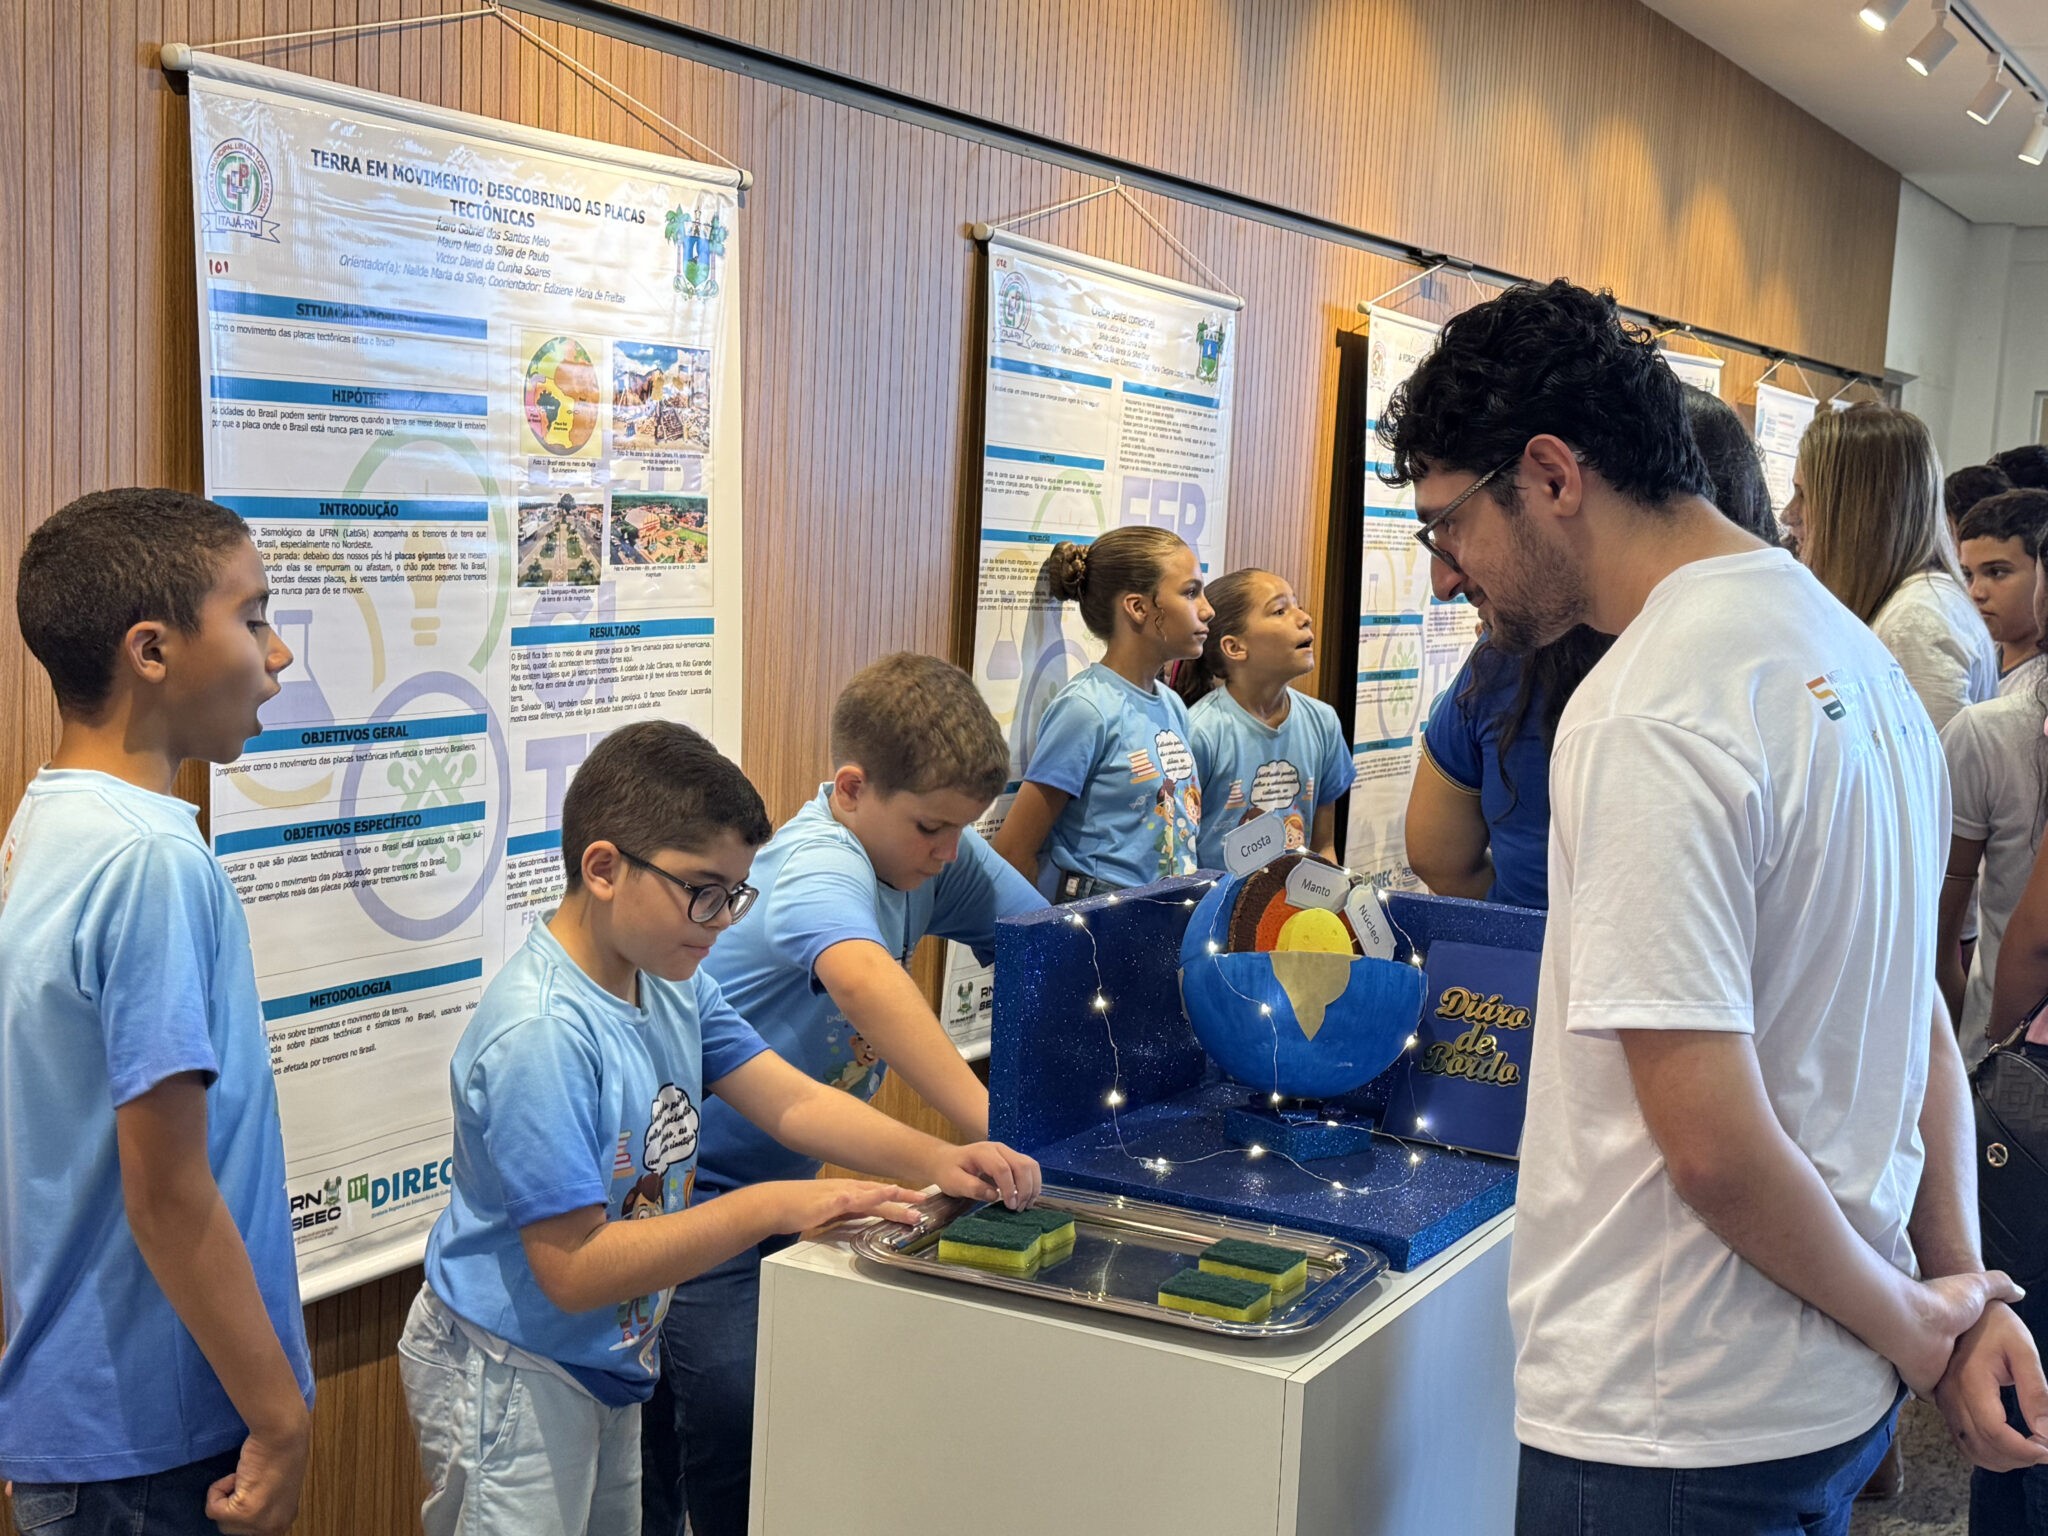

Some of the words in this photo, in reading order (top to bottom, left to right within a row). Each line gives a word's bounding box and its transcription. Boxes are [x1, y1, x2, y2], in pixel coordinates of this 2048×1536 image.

[311, 149, 361, 174] TERRA
[367, 159, 388, 179] EM
[393, 164, 483, 195] MOVIMENTO:
[487, 182, 582, 213] DESCOBRINDO
[586, 200, 601, 216] AS
[605, 204, 646, 224] PLACAS
[218, 216, 258, 230] ITAJÁ-RN
[450, 199, 535, 228] TECTÔNICAS
[458, 223, 484, 238] Gabriel
[486, 227, 500, 240] dos
[502, 230, 530, 244] Santos
[532, 234, 550, 248] Melo
[437, 236, 462, 249] Mauro
[464, 241, 482, 253] Neto
[484, 244, 493, 255] da
[494, 245, 514, 258] Silva
[516, 248, 526, 259] de
[528, 250, 549, 262] Paulo
[340, 254, 400, 276] Orientador(a):
[430, 268, 452, 281] Maria
[454, 271, 464, 282] da
[594, 290, 604, 300] de
[485, 258, 495, 270] da
[497, 260, 522, 274] Cunha
[524, 265, 550, 278] Soares
[236, 325, 276, 336] movimento
[278, 328, 291, 338] das
[294, 330, 315, 340] placas
[316, 332, 350, 344] tectônicas
[220, 407, 244, 416] cidades
[247, 408, 256, 417] do
[258, 409, 278, 418] Brasil
[280, 410, 304, 420] podem
[307, 411, 326, 420] sentir
[329, 413, 358, 423] tremores
[242, 420, 260, 430] placa
[262, 422, 280, 430] onde
[290, 422, 308, 432] Brasil
[320, 502, 399, 518] INTRODUÇÃO
[261, 527, 302, 538] Sismológico
[306, 528, 315, 537] da
[320, 528, 338, 538] UFRN
[373, 529, 408, 538] acompanha
[422, 530, 447, 538] tremores
[450, 530, 458, 538] de
[257, 540, 278, 550] Brasil,
[280, 540, 330, 550] especialmente
[342, 540, 373, 549] Nordeste.
[274, 552, 300, 561] parada:
[303, 552, 330, 560] debaixo
[332, 552, 344, 560] dos
[346, 552, 368, 560] nossos
[394, 552, 416, 562] placas
[418, 552, 446, 562] gigantes
[272, 575, 296, 584] bordas
[298, 574, 321, 583] dessas
[324, 574, 347, 584] placas,
[380, 574, 404, 582] também
[406, 574, 432, 582] sentimos
[286, 564, 300, 572] elas
[316, 564, 350, 573] empurram
[366, 562, 394, 572] afastam,
[421, 563, 436, 572] pode
[471, 562, 487, 571] Brasil,
[322, 586, 331, 594] de
[590, 624, 640, 638] RESULTADOS
[517, 652, 530, 660] Brasil
[302, 728, 370, 744] OBJETIVOS
[373, 726, 408, 740] GERAL
[280, 758, 316, 769] movimento
[332, 754, 354, 766] placas
[356, 752, 388, 763] tectônicas
[284, 822, 350, 842] OBJETIVOS
[354, 814, 422, 832] ESPECÍFICO
[272, 856, 284, 866] são
[288, 855, 308, 865] placas
[311, 850, 344, 861] tectônicas
[354, 845, 371, 855] onde
[382, 842, 399, 852] Brasil
[416, 837, 444, 847] localizado
[1240, 834, 1272, 858] Crosta
[256, 882, 273, 891] como
[282, 876, 316, 887] movimento
[332, 870, 353, 882] placas
[354, 868, 371, 878] pode
[373, 866, 390, 876] gerar
[392, 862, 418, 871] tremores
[430, 856, 447, 866] Brasil.
[258, 892, 289, 903] exemplos
[308, 886, 320, 895] das
[321, 884, 341, 894] placas
[342, 881, 360, 892] pode
[362, 877, 378, 888] gerar
[380, 874, 408, 883] tremores
[420, 869, 438, 878] Brasil.
[1300, 878, 1330, 897] Manto
[1358, 904, 1380, 945] Núcleo
[309, 980, 392, 1008] METODOLOGIA
[287, 1040, 305, 1051] sobre
[310, 1034, 329, 1048] placas
[333, 1025, 362, 1040] tectônicas
[374, 1016, 400, 1030] sísmicos
[418, 1009, 436, 1022] Brasil,
[440, 1004, 462, 1016] usando
[288, 1027, 306, 1039] sobre
[308, 1020, 340, 1036] terremotos
[348, 1010, 380, 1026] movimento
[382, 1008, 390, 1018] da
[392, 1005, 408, 1016] terra.
[1453, 1022, 1498, 1057] de
[283, 1061, 308, 1074] afetada
[322, 1052, 348, 1065] tremores
[359, 1043, 376, 1054] Brasil.
[1420, 1041, 1520, 1087] Bordo
[372, 1156, 452, 1209] DIREC
[290, 1190, 322, 1213] RN
[292, 1206, 342, 1232] SEEC
